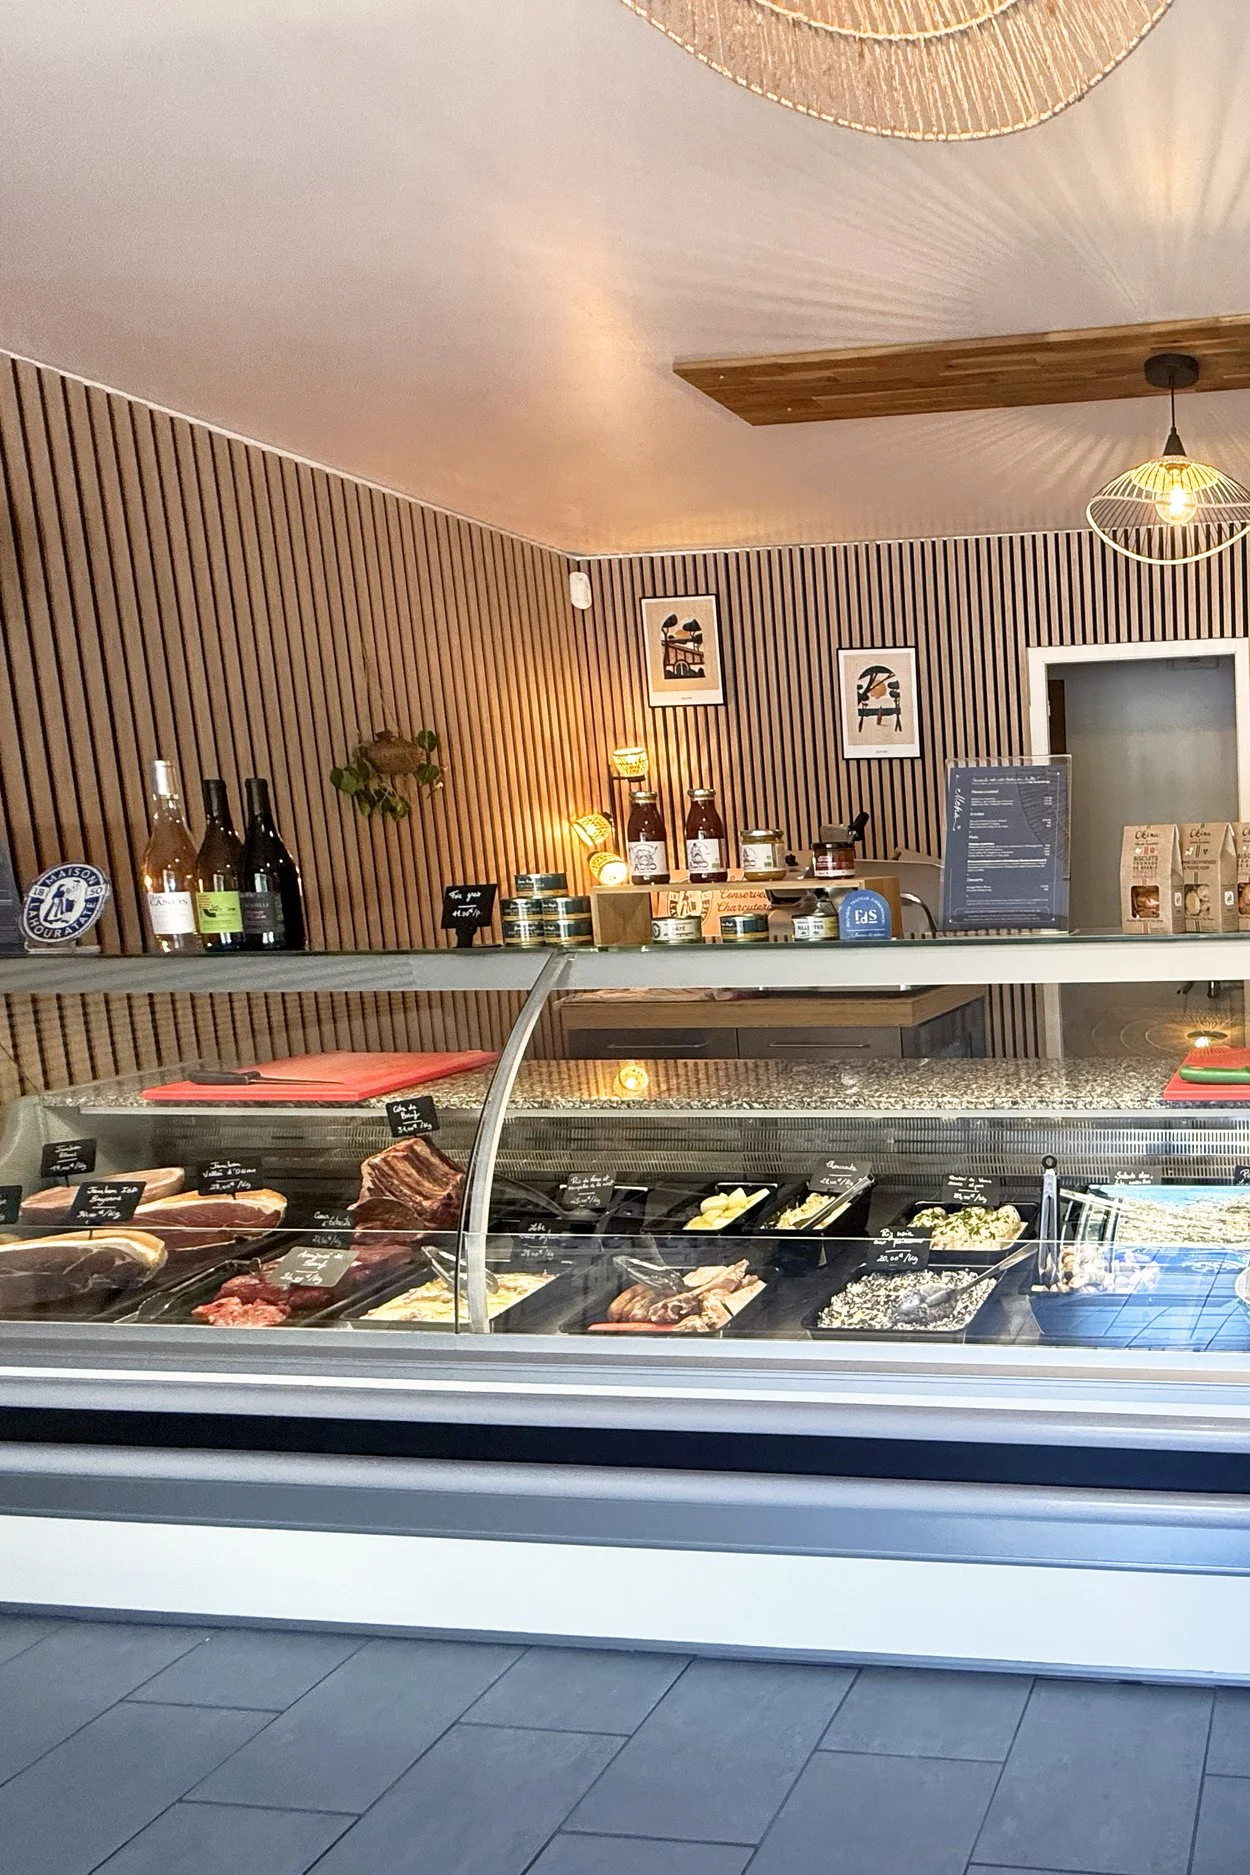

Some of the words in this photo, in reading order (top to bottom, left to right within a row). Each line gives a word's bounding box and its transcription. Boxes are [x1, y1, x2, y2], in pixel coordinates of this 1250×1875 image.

[46, 867, 98, 886] MAISON
[33, 887, 45, 896] 18
[90, 886, 103, 895] 50
[27, 900, 97, 939] LAHOURATATE
